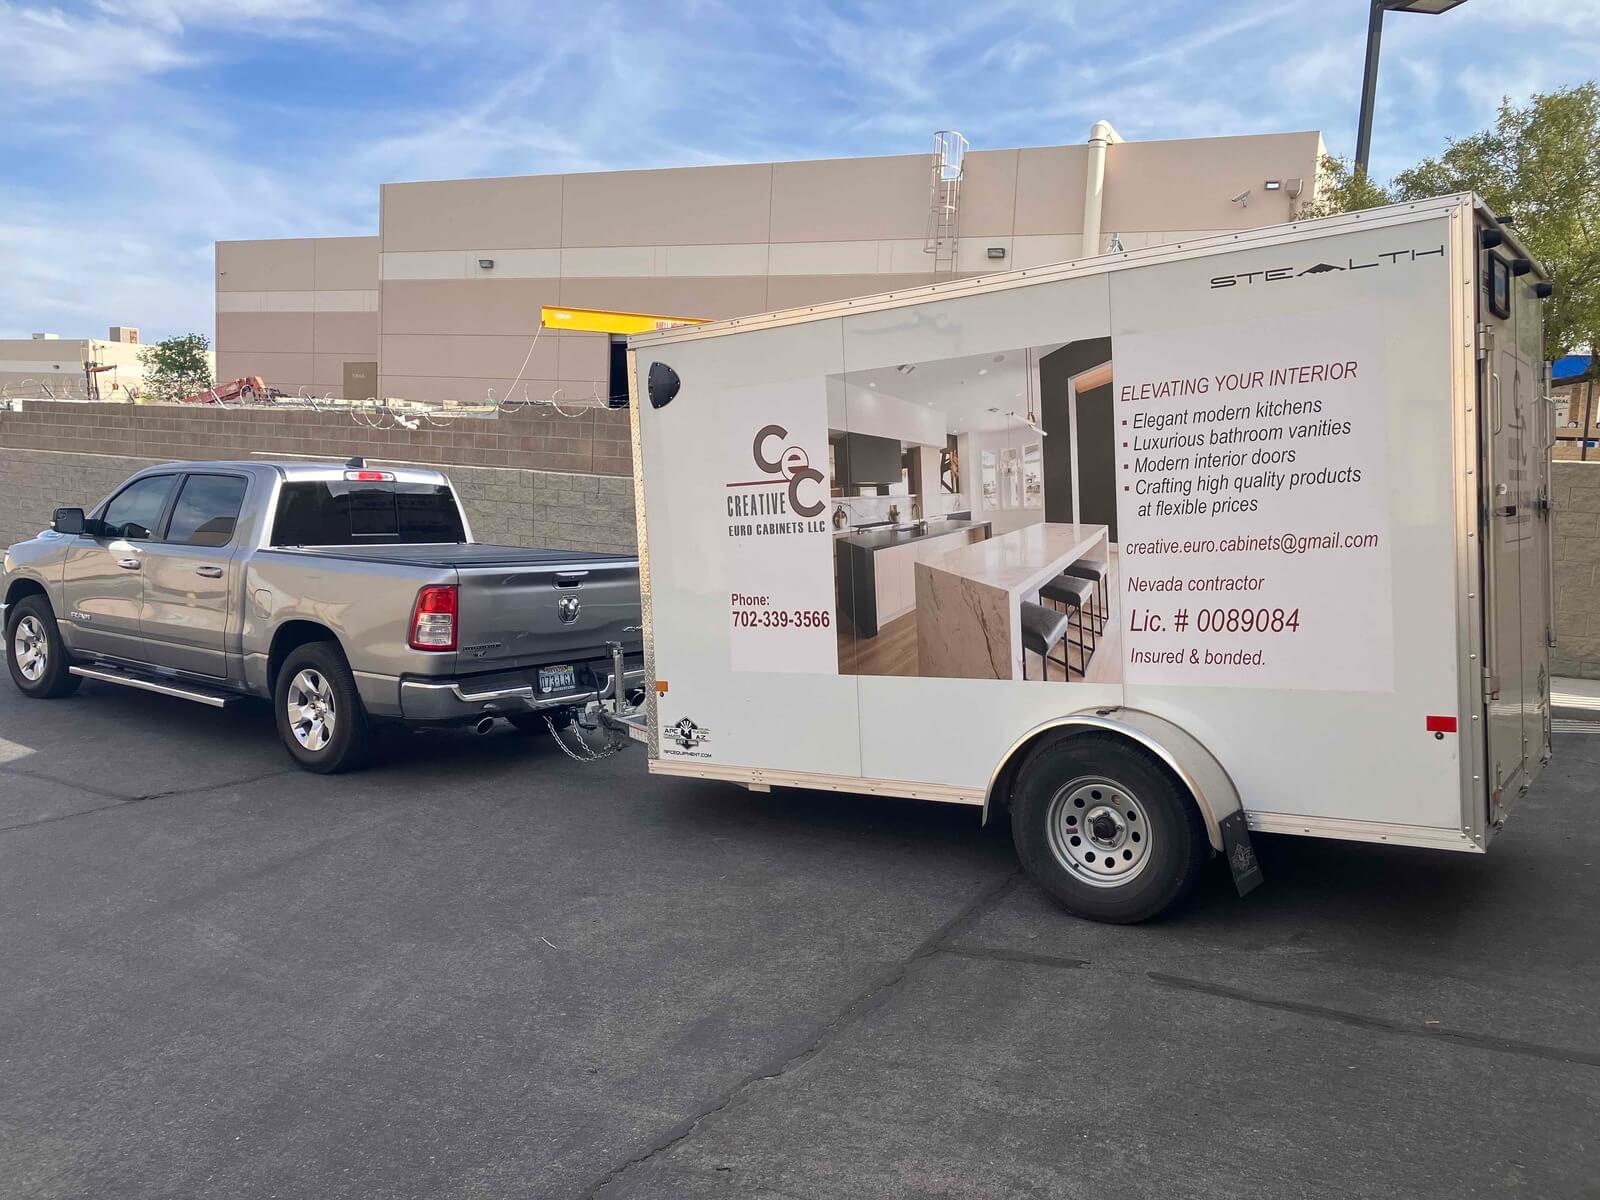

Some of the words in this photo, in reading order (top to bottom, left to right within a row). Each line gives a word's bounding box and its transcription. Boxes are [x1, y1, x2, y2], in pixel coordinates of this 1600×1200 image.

[1210, 245, 1444, 289] STEALTH
[1121, 377, 1209, 402] ELEVATING
[1215, 371, 1264, 392] YOUR
[1269, 361, 1358, 386] INTERIOR
[1133, 410, 1188, 431] Elegant
[1193, 404, 1250, 424] modern
[1256, 399, 1322, 418] kitchens
[1134, 432, 1204, 451] Luxurious
[1209, 426, 1283, 445] bathroom
[1288, 419, 1351, 439] vanities
[1134, 455, 1189, 473] Modern
[1194, 450, 1247, 469] interior
[1252, 448, 1296, 466] doors
[1135, 476, 1192, 496] Crafting
[1197, 473, 1229, 494] high
[1234, 471, 1284, 492] quality
[1289, 466, 1361, 490] products
[727, 492, 786, 517] CREATIVE
[1138, 501, 1151, 517] at
[1156, 499, 1207, 517] flexible
[1212, 497, 1258, 517] prices
[728, 524, 753, 537] EURO
[756, 521, 804, 536] CABINETS
[807, 520, 826, 533] LLC
[1126, 532, 1379, 555] creative.euro.cabinets@gmail.com
[1128, 577, 1183, 593] Nevada
[1188, 575, 1265, 592] contractor
[731, 593, 770, 607] Phone:
[732, 610, 831, 628] 702-339-3566
[1130, 608, 1167, 632] Lic.
[1174, 608, 1189, 633] #
[1197, 608, 1300, 633] 0089084
[1130, 647, 1184, 664] Insured
[1189, 649, 1200, 665] &
[1205, 649, 1266, 666] bonded.
